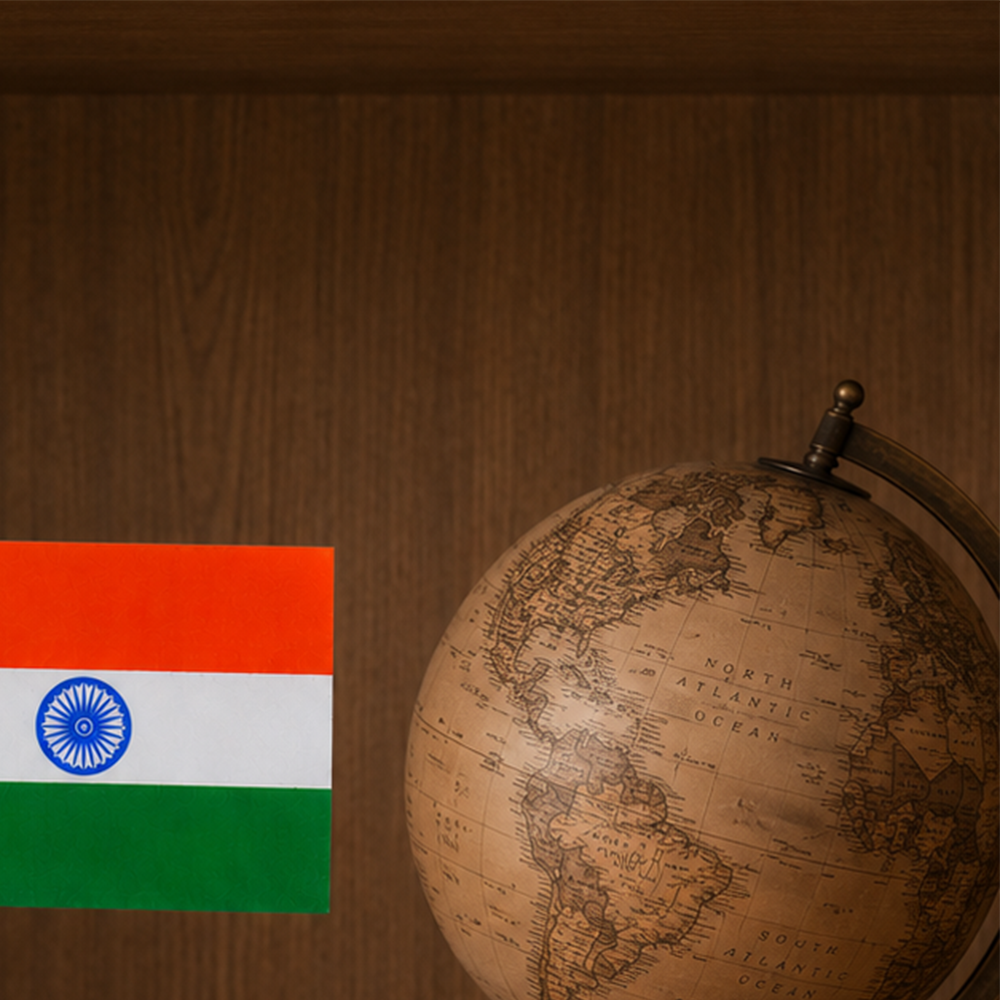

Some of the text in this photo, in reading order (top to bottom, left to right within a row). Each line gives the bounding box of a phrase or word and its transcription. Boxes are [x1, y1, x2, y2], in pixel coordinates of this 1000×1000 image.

[704, 657, 793, 691] NORTH
[676, 676, 811, 722] ATLANTIC
[694, 709, 780, 743] OCEAN
[757, 930, 839, 956] SOUTH
[723, 948, 848, 981] ATLANTIC
[738, 974, 817, 999] OCEAN
